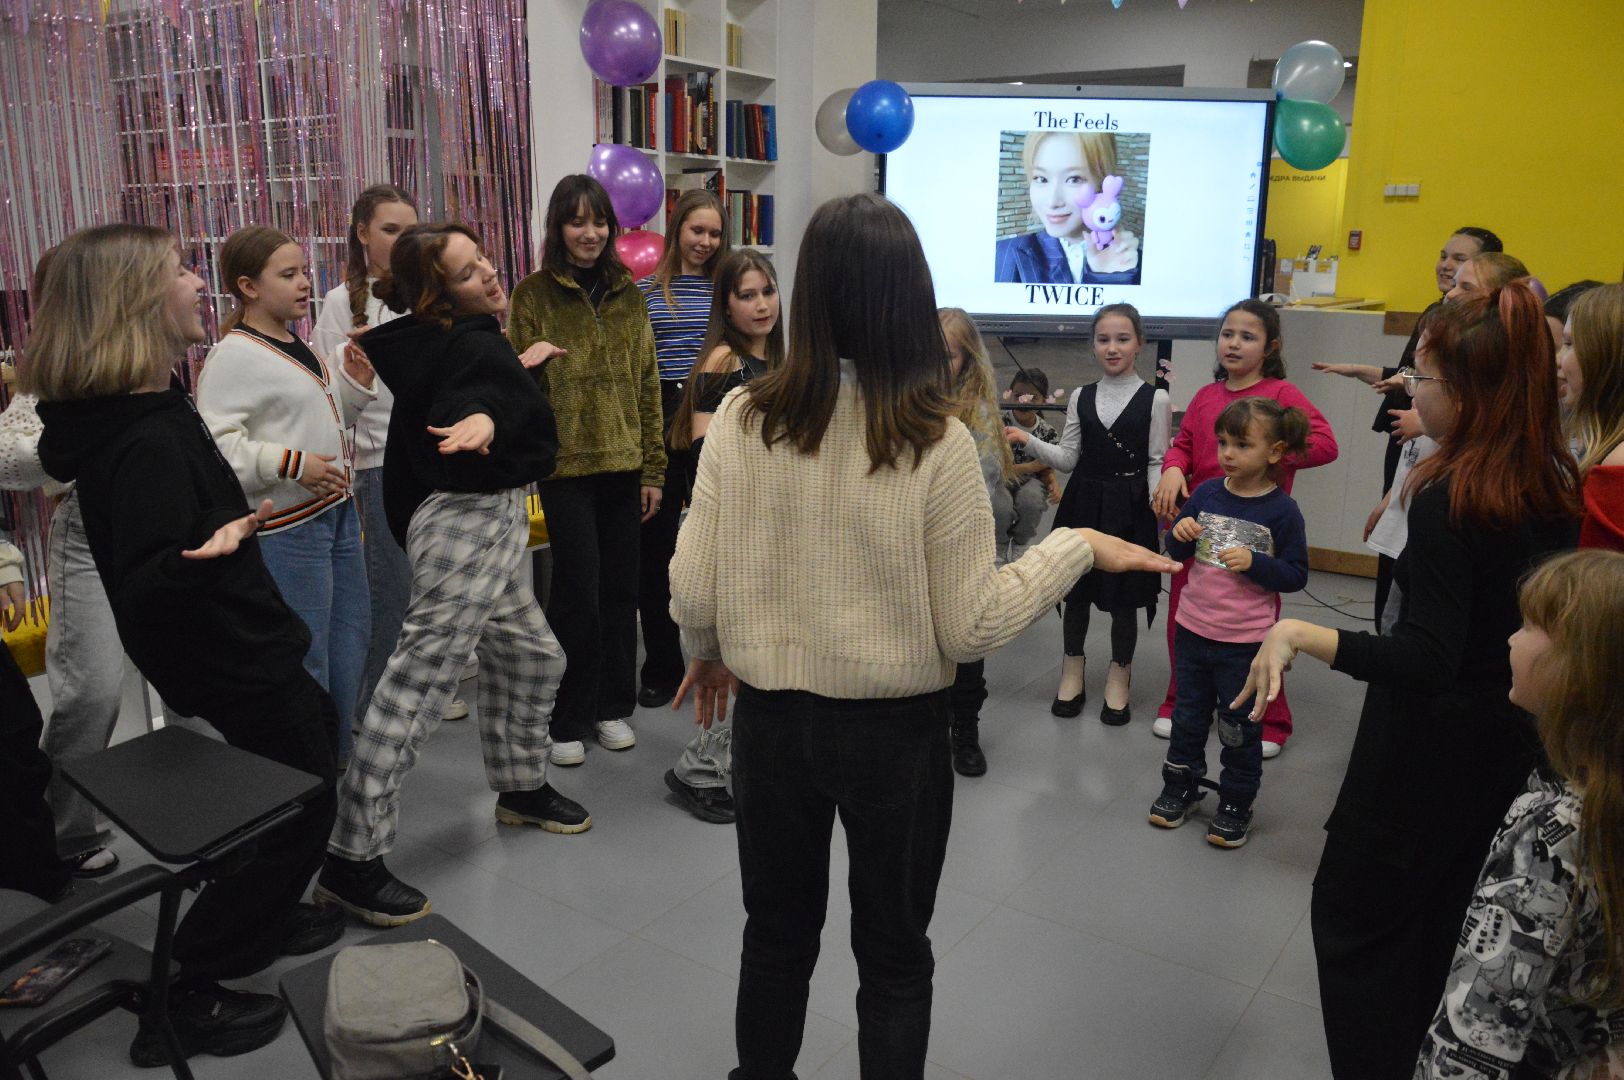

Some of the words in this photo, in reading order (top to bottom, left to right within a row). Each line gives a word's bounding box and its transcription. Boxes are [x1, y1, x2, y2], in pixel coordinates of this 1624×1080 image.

[1033, 110, 1068, 128] The
[1073, 112, 1119, 131] Feels
[1025, 284, 1104, 306] TWICE
